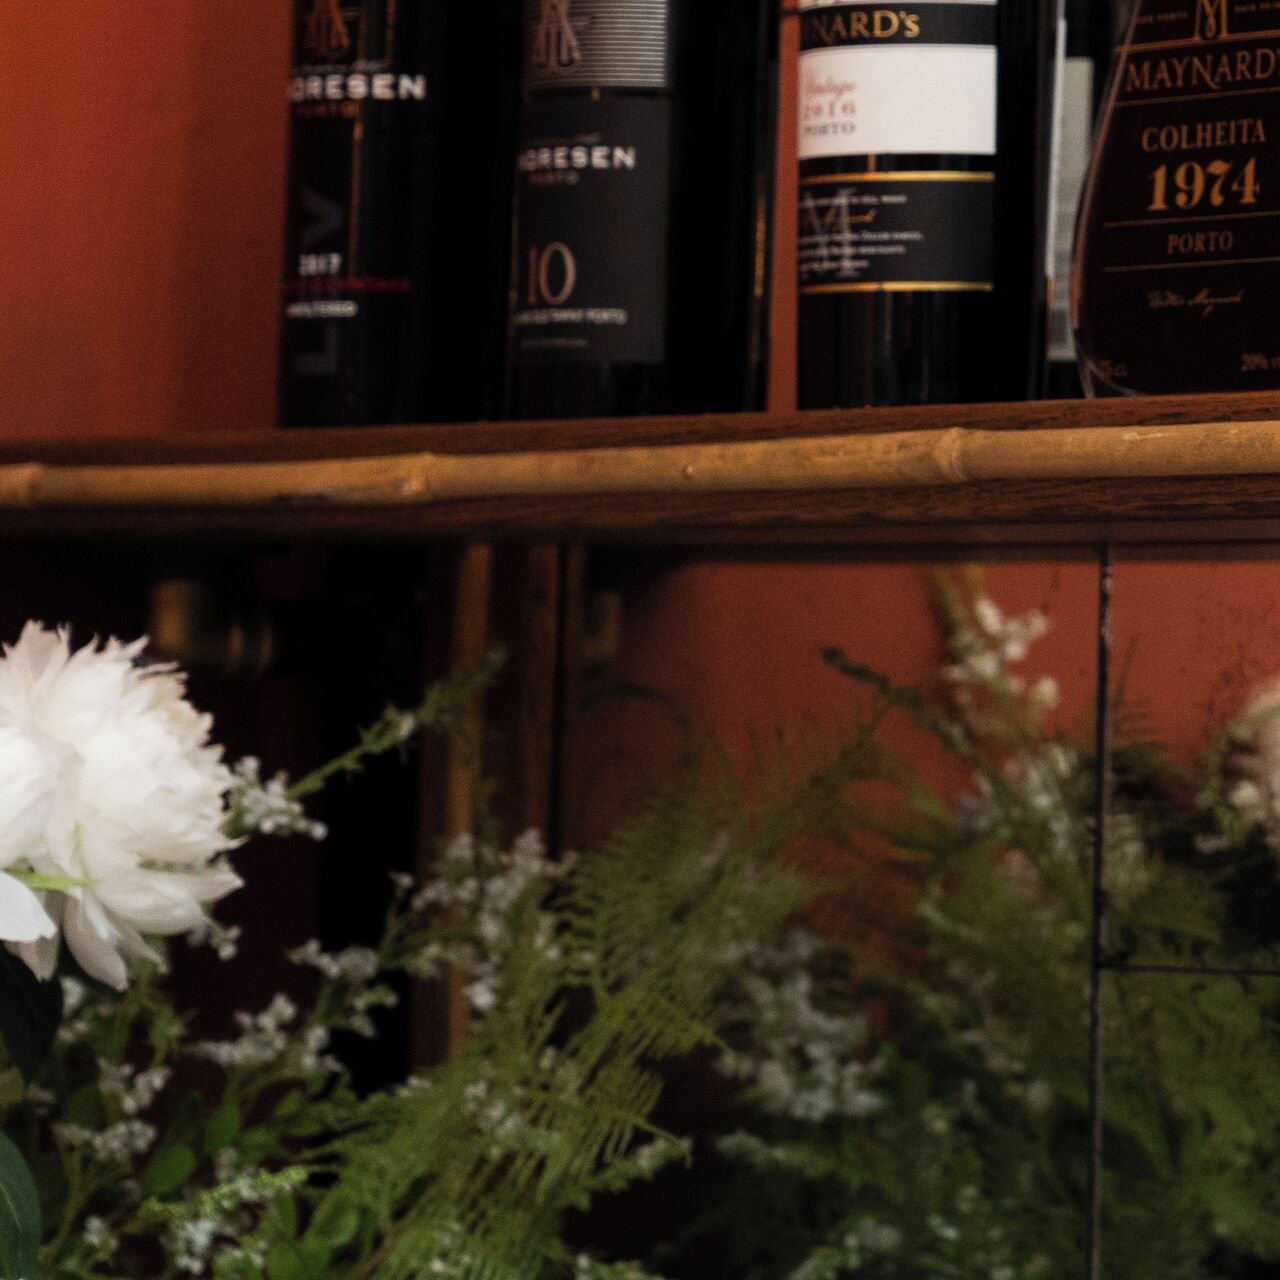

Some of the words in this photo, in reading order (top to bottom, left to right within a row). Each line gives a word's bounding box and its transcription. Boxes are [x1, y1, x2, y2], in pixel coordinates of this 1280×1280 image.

[1141, 118, 1266, 153] COLHEITA
[1147, 158, 1260, 212] 1974
[1167, 230, 1234, 255] PORTO
[528, 241, 577, 305] 10
